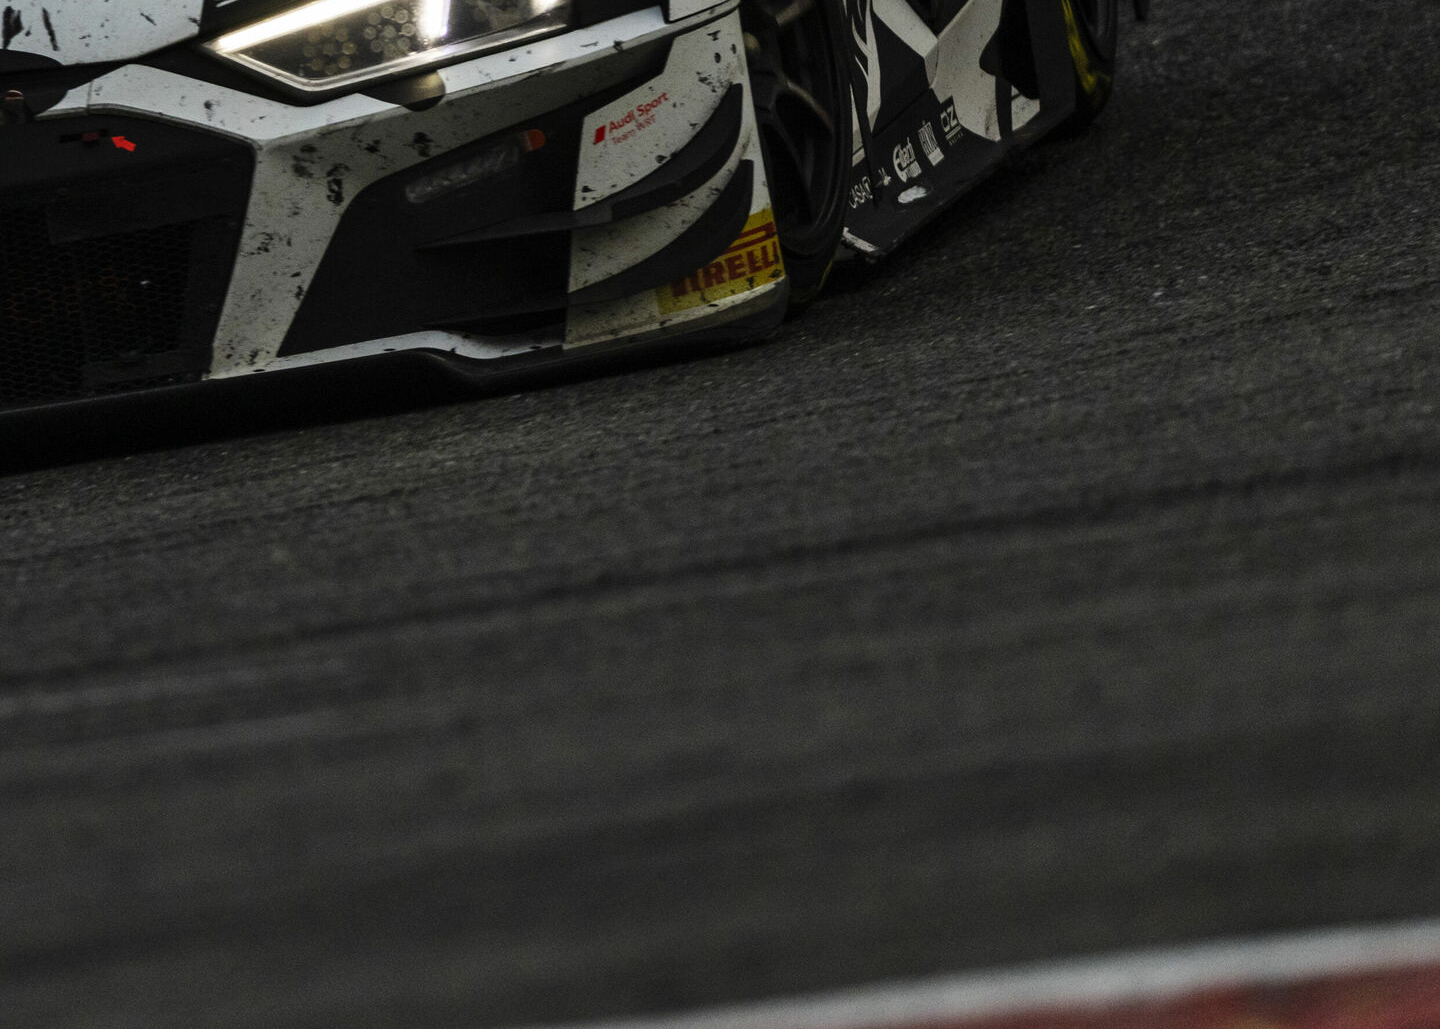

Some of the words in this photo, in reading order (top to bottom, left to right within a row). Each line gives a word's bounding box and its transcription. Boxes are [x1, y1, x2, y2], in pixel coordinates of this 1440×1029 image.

[608, 110, 636, 134] Audi
[636, 91, 670, 119] Sport
[611, 127, 638, 146] Team
[635, 114, 657, 132] WRT
